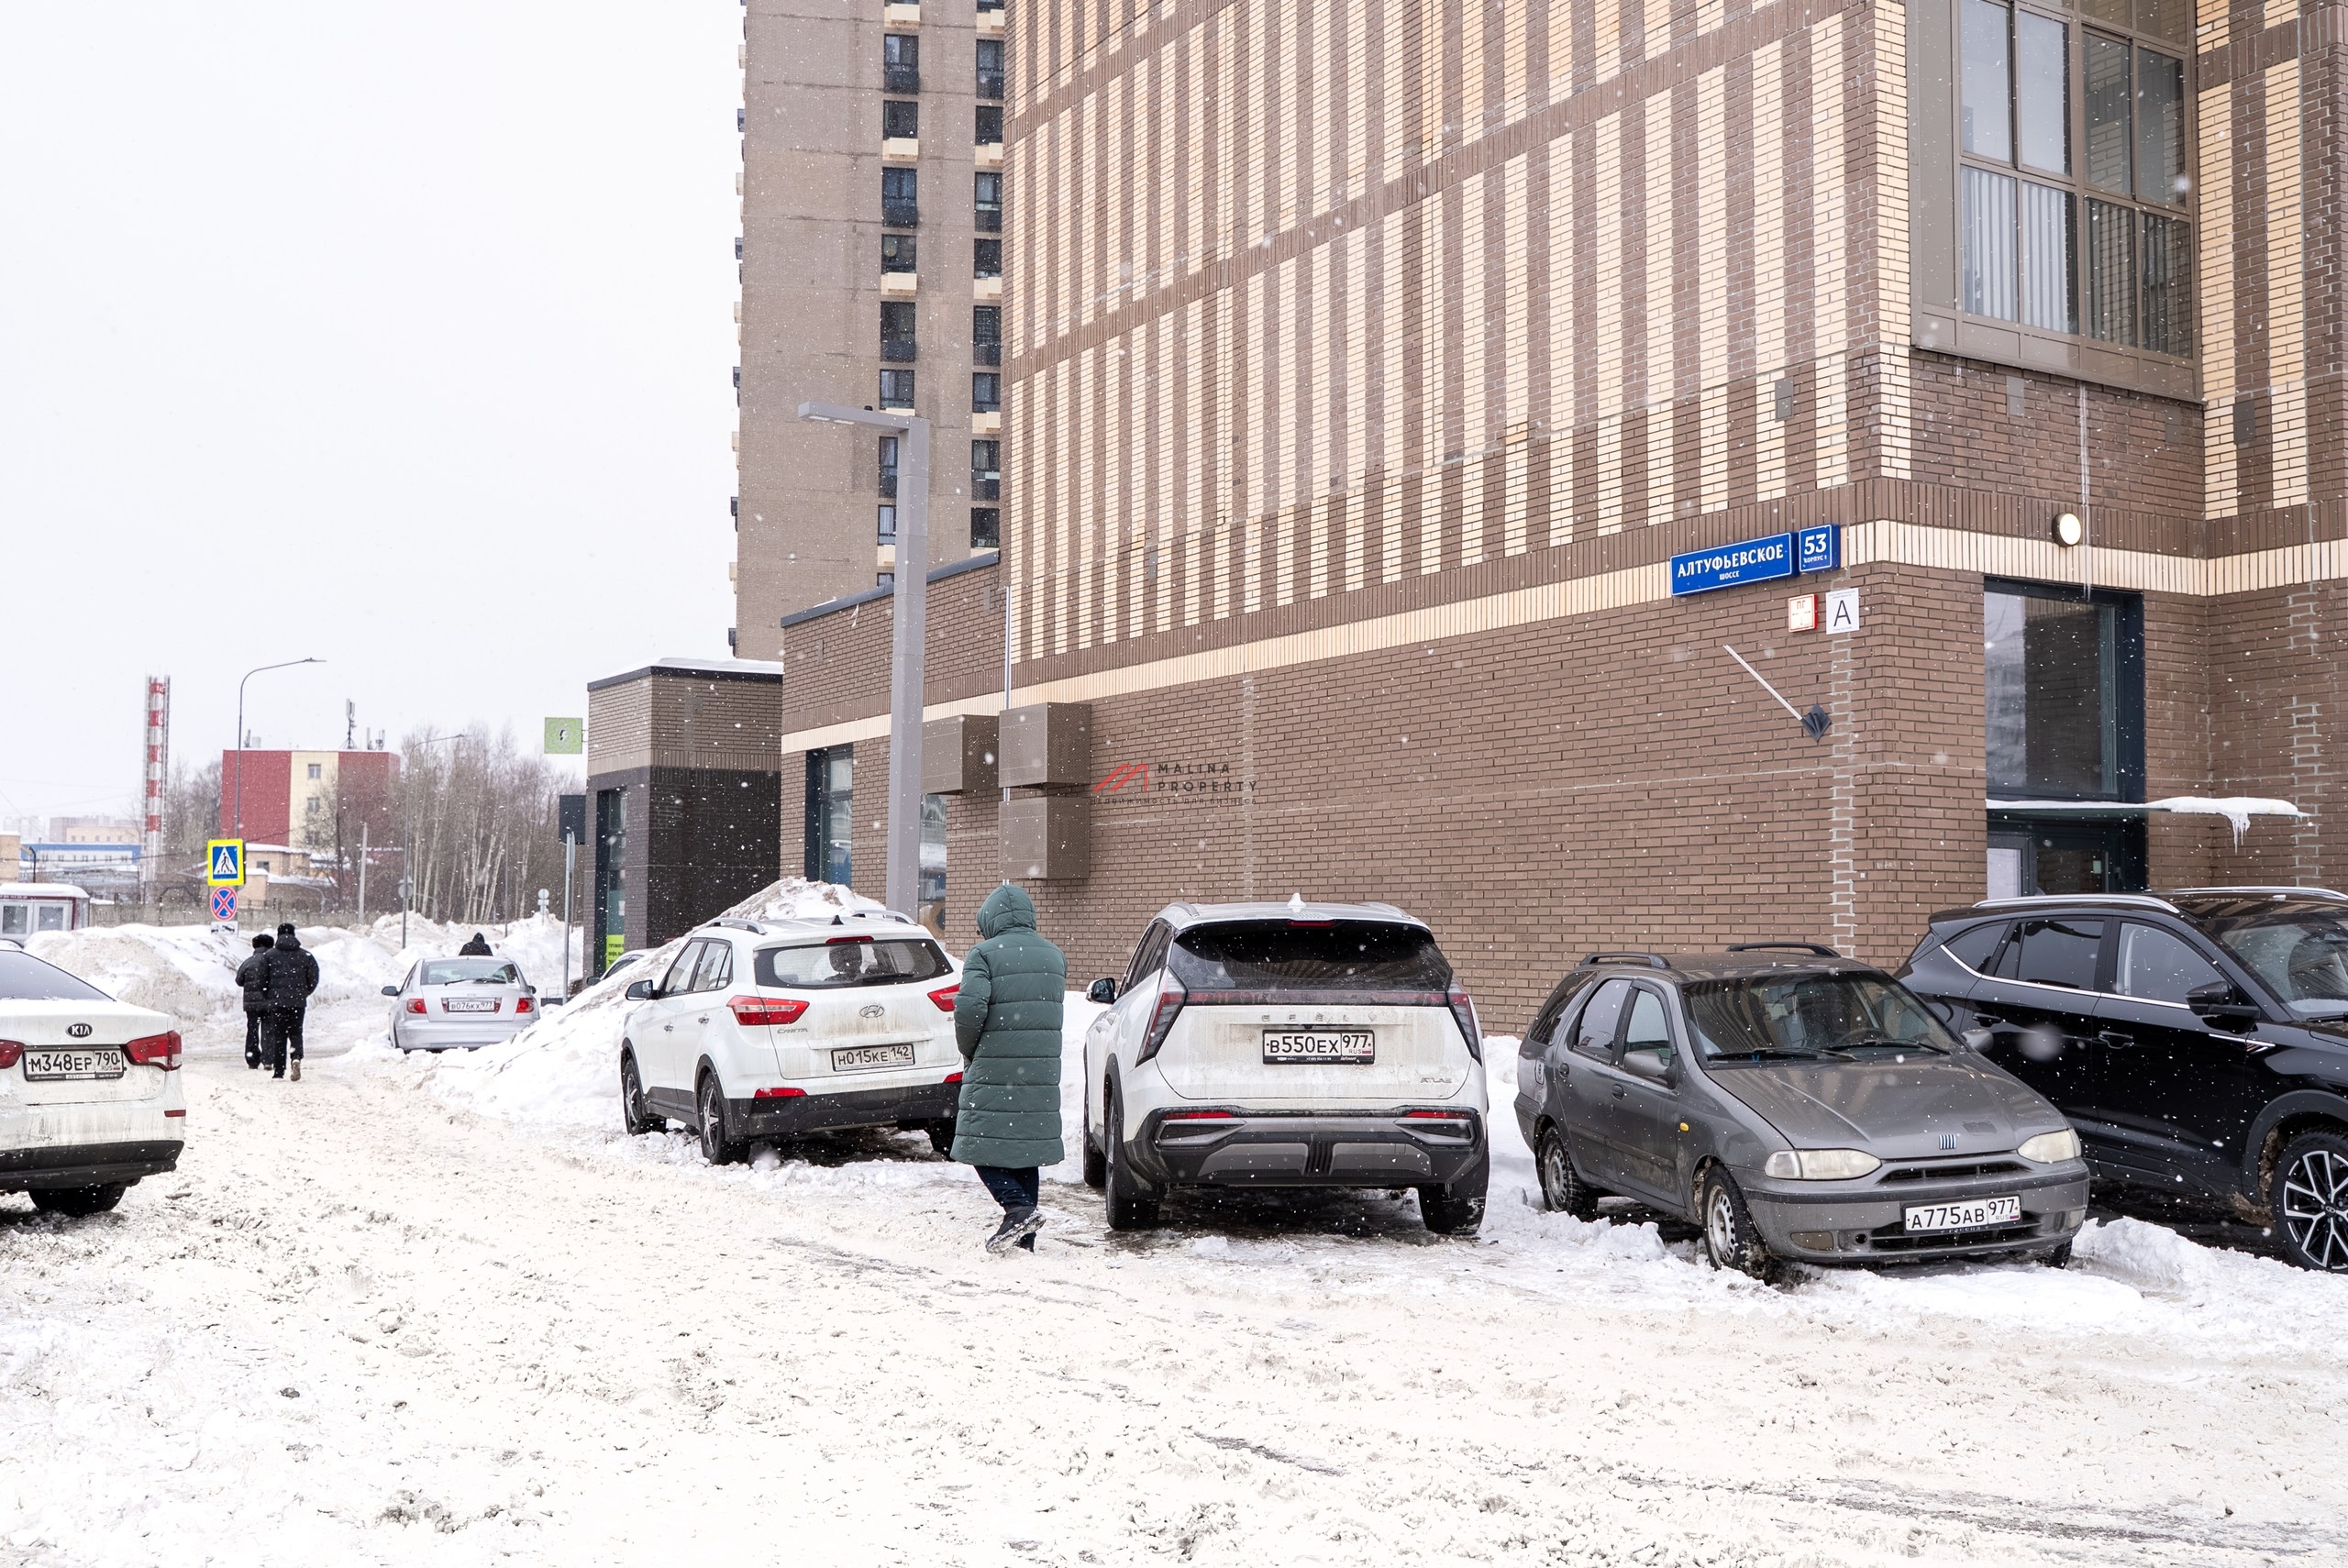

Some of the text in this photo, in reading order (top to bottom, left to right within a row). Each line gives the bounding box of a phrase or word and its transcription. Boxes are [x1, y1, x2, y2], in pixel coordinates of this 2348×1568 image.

[1804, 534, 1827, 555] 53
[1678, 544, 1784, 578] АЛТУФЬЕВСКОЕ
[1803, 555, 1823, 564] КОРПУС
[1719, 570, 1740, 580] ШОССЕ
[1833, 600, 1852, 627] А
[72, 1025, 91, 1035] KIA
[1269, 1034, 1368, 1054] В550ЕХ 977
[30, 1052, 118, 1072] М348ЕР 790
[837, 1046, 909, 1066] Н015КЕ 142
[1911, 1198, 2015, 1229] А775АВ 977
